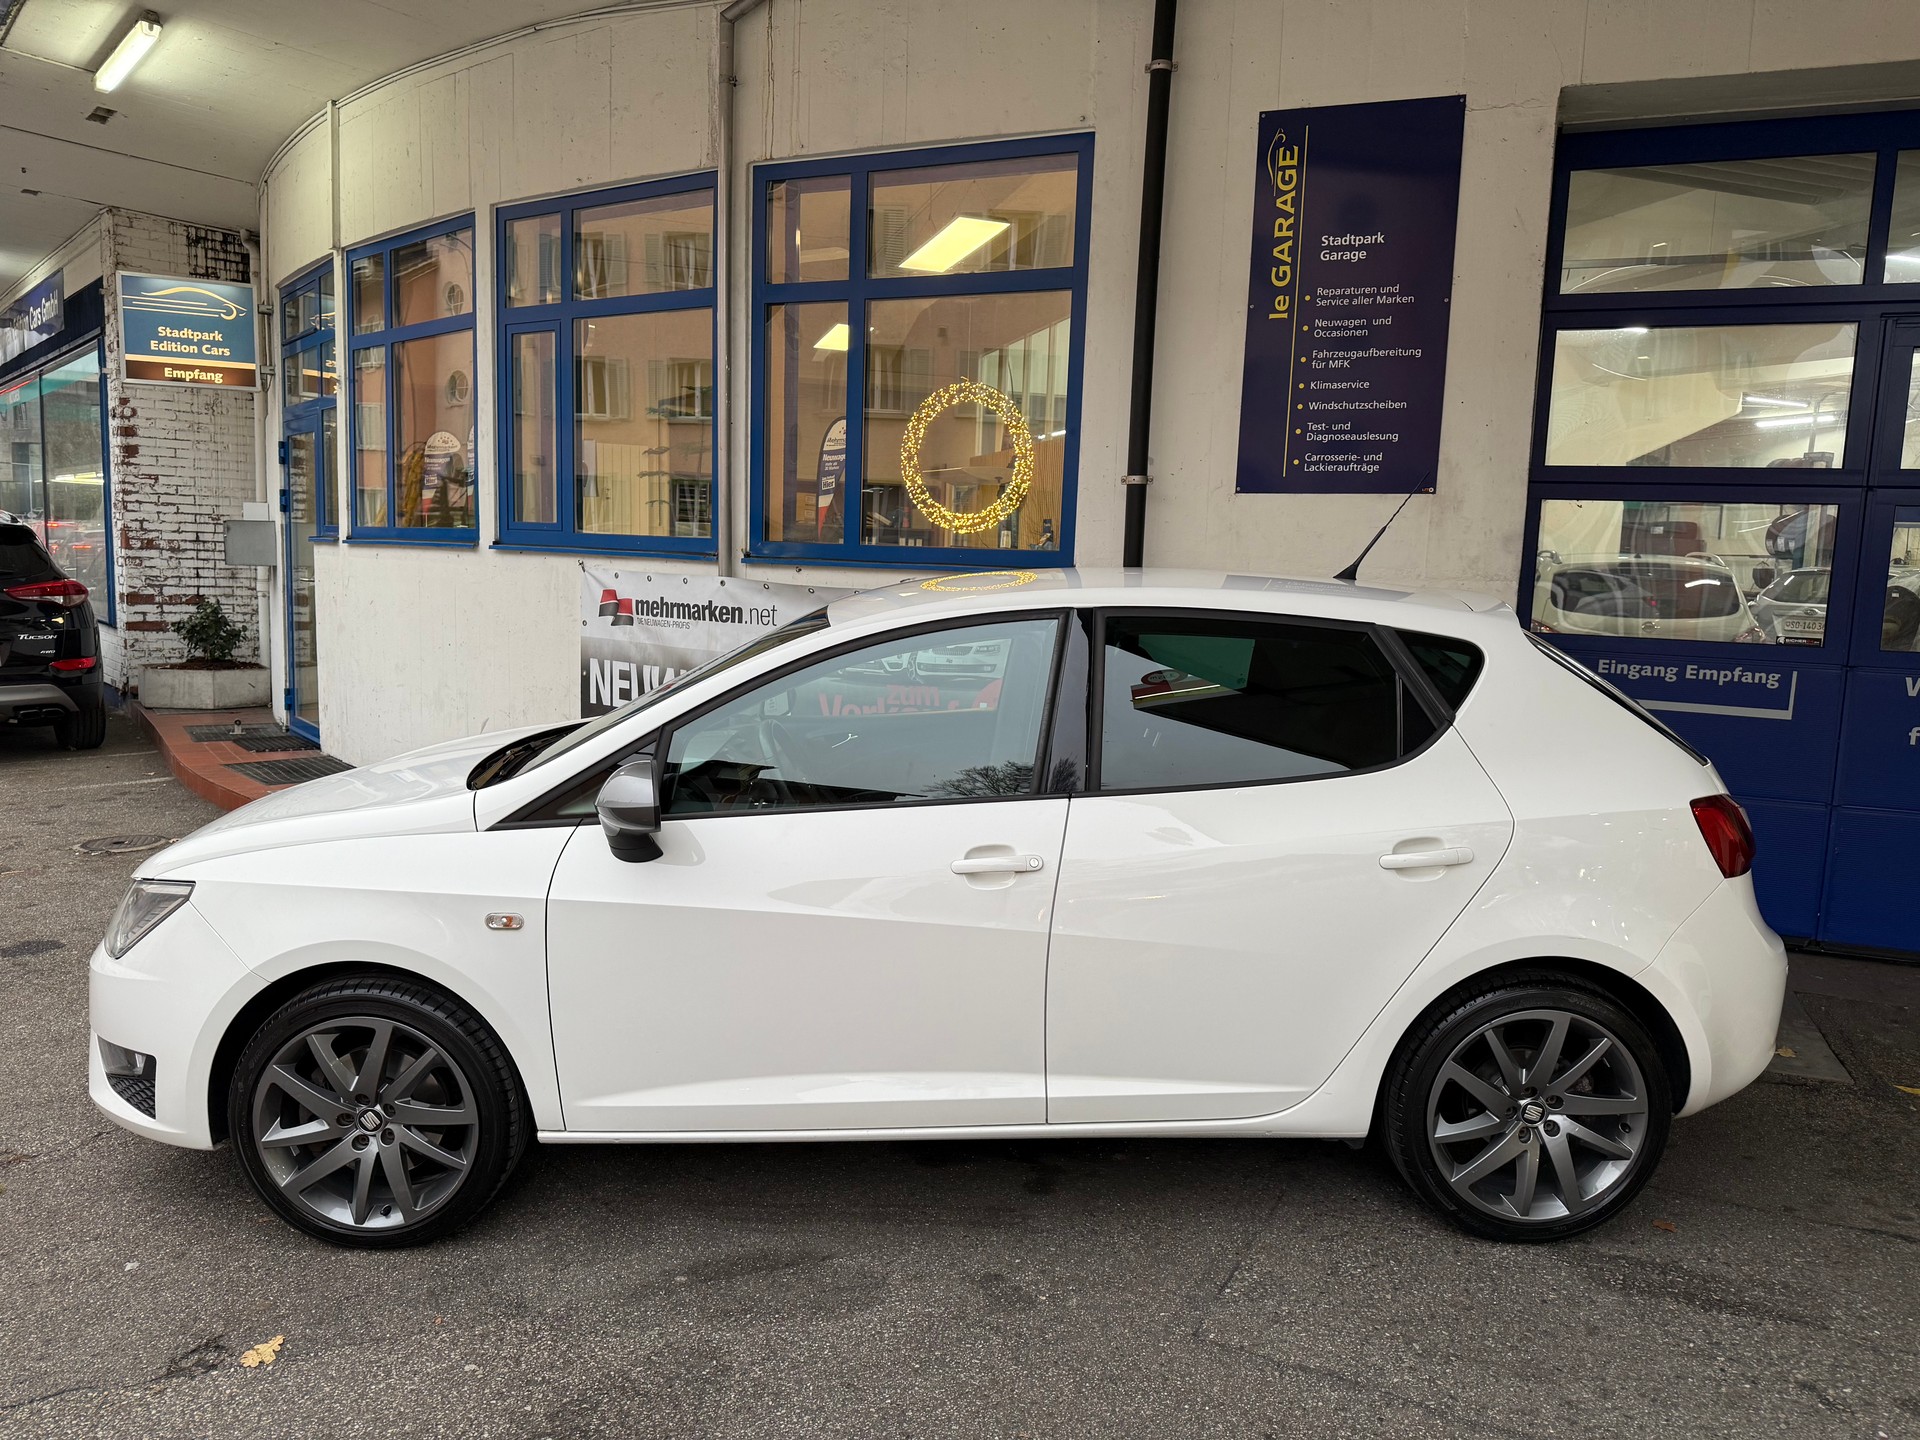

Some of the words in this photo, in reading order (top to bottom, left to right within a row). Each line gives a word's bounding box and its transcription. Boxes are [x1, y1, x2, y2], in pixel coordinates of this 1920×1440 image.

[1271, 144, 1299, 288] GARAGE
[1321, 231, 1385, 247] Stadtpark
[1320, 249, 1367, 262] Garage
[1316, 286, 1377, 297] Reparaturen
[1380, 283, 1400, 294] und
[1269, 294, 1290, 320] le
[1316, 296, 1350, 307] Service
[1351, 295, 1374, 305] aller
[1376, 294, 1415, 304] Marken
[29, 306, 42, 330] Cars
[1314, 318, 1367, 329] Neuwagen
[1372, 315, 1392, 325] und
[158, 326, 223, 342] Stadtpark
[1313, 328, 1369, 338] Occasionen
[150, 340, 198, 354] Edition
[202, 344, 231, 356] Cars
[1312, 347, 1422, 360] Fahrzeugaufbereitung
[1311, 359, 1326, 369] für
[1328, 359, 1351, 369] MFK
[164, 367, 224, 384] Empfang
[1310, 379, 1370, 390] Klimaservice
[1308, 400, 1407, 410] Windschutzscheiben
[1307, 422, 1329, 431] Test-
[1332, 421, 1351, 431] und
[1306, 431, 1399, 443] Diagnoseauslesung
[1304, 452, 1360, 462] Carrosserie-
[1363, 452, 1383, 461] und
[1304, 462, 1380, 474] Lackieraufträge
[823, 480, 834, 488] Hier
[635, 596, 778, 627] mehrmarken.net
[1597, 658, 1679, 683] Eingang
[1685, 664, 1781, 690] Empfang
